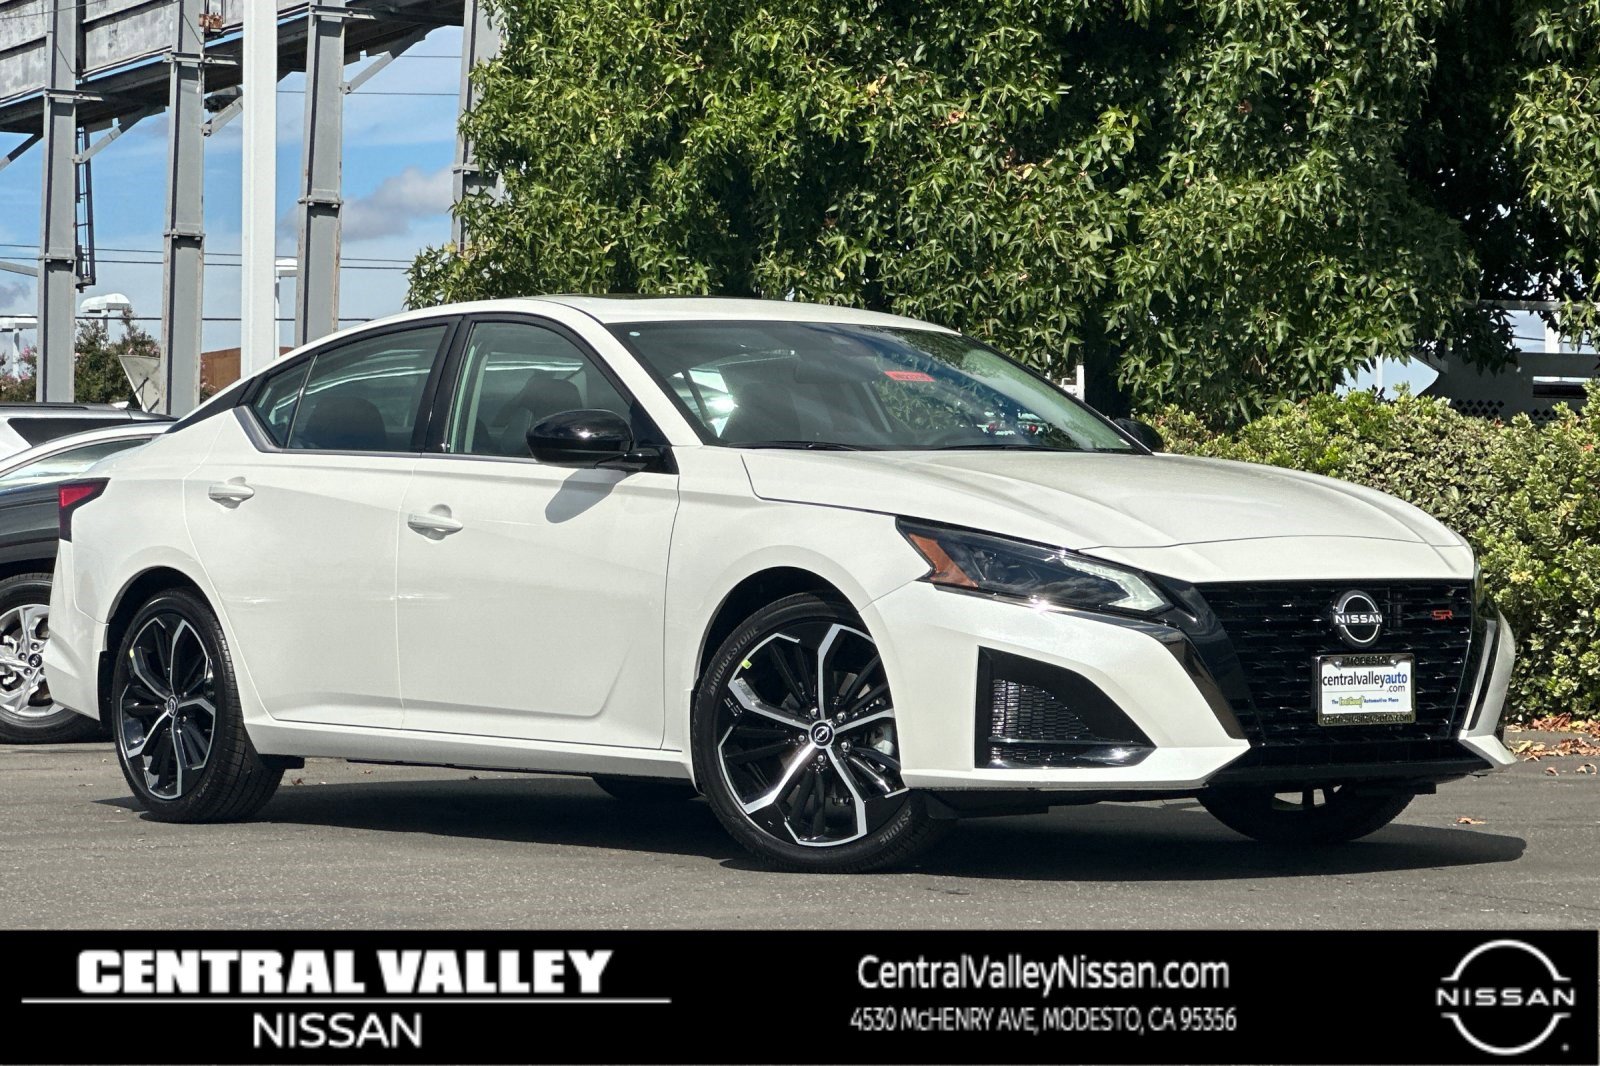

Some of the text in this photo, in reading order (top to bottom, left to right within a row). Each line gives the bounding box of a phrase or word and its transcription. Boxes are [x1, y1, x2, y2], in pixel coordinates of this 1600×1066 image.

[1335, 614, 1383, 624] NISSAN
[1430, 609, 1453, 621] SR
[1322, 670, 1408, 688] centralvalleyauto
[1386, 684, 1406, 693] .com
